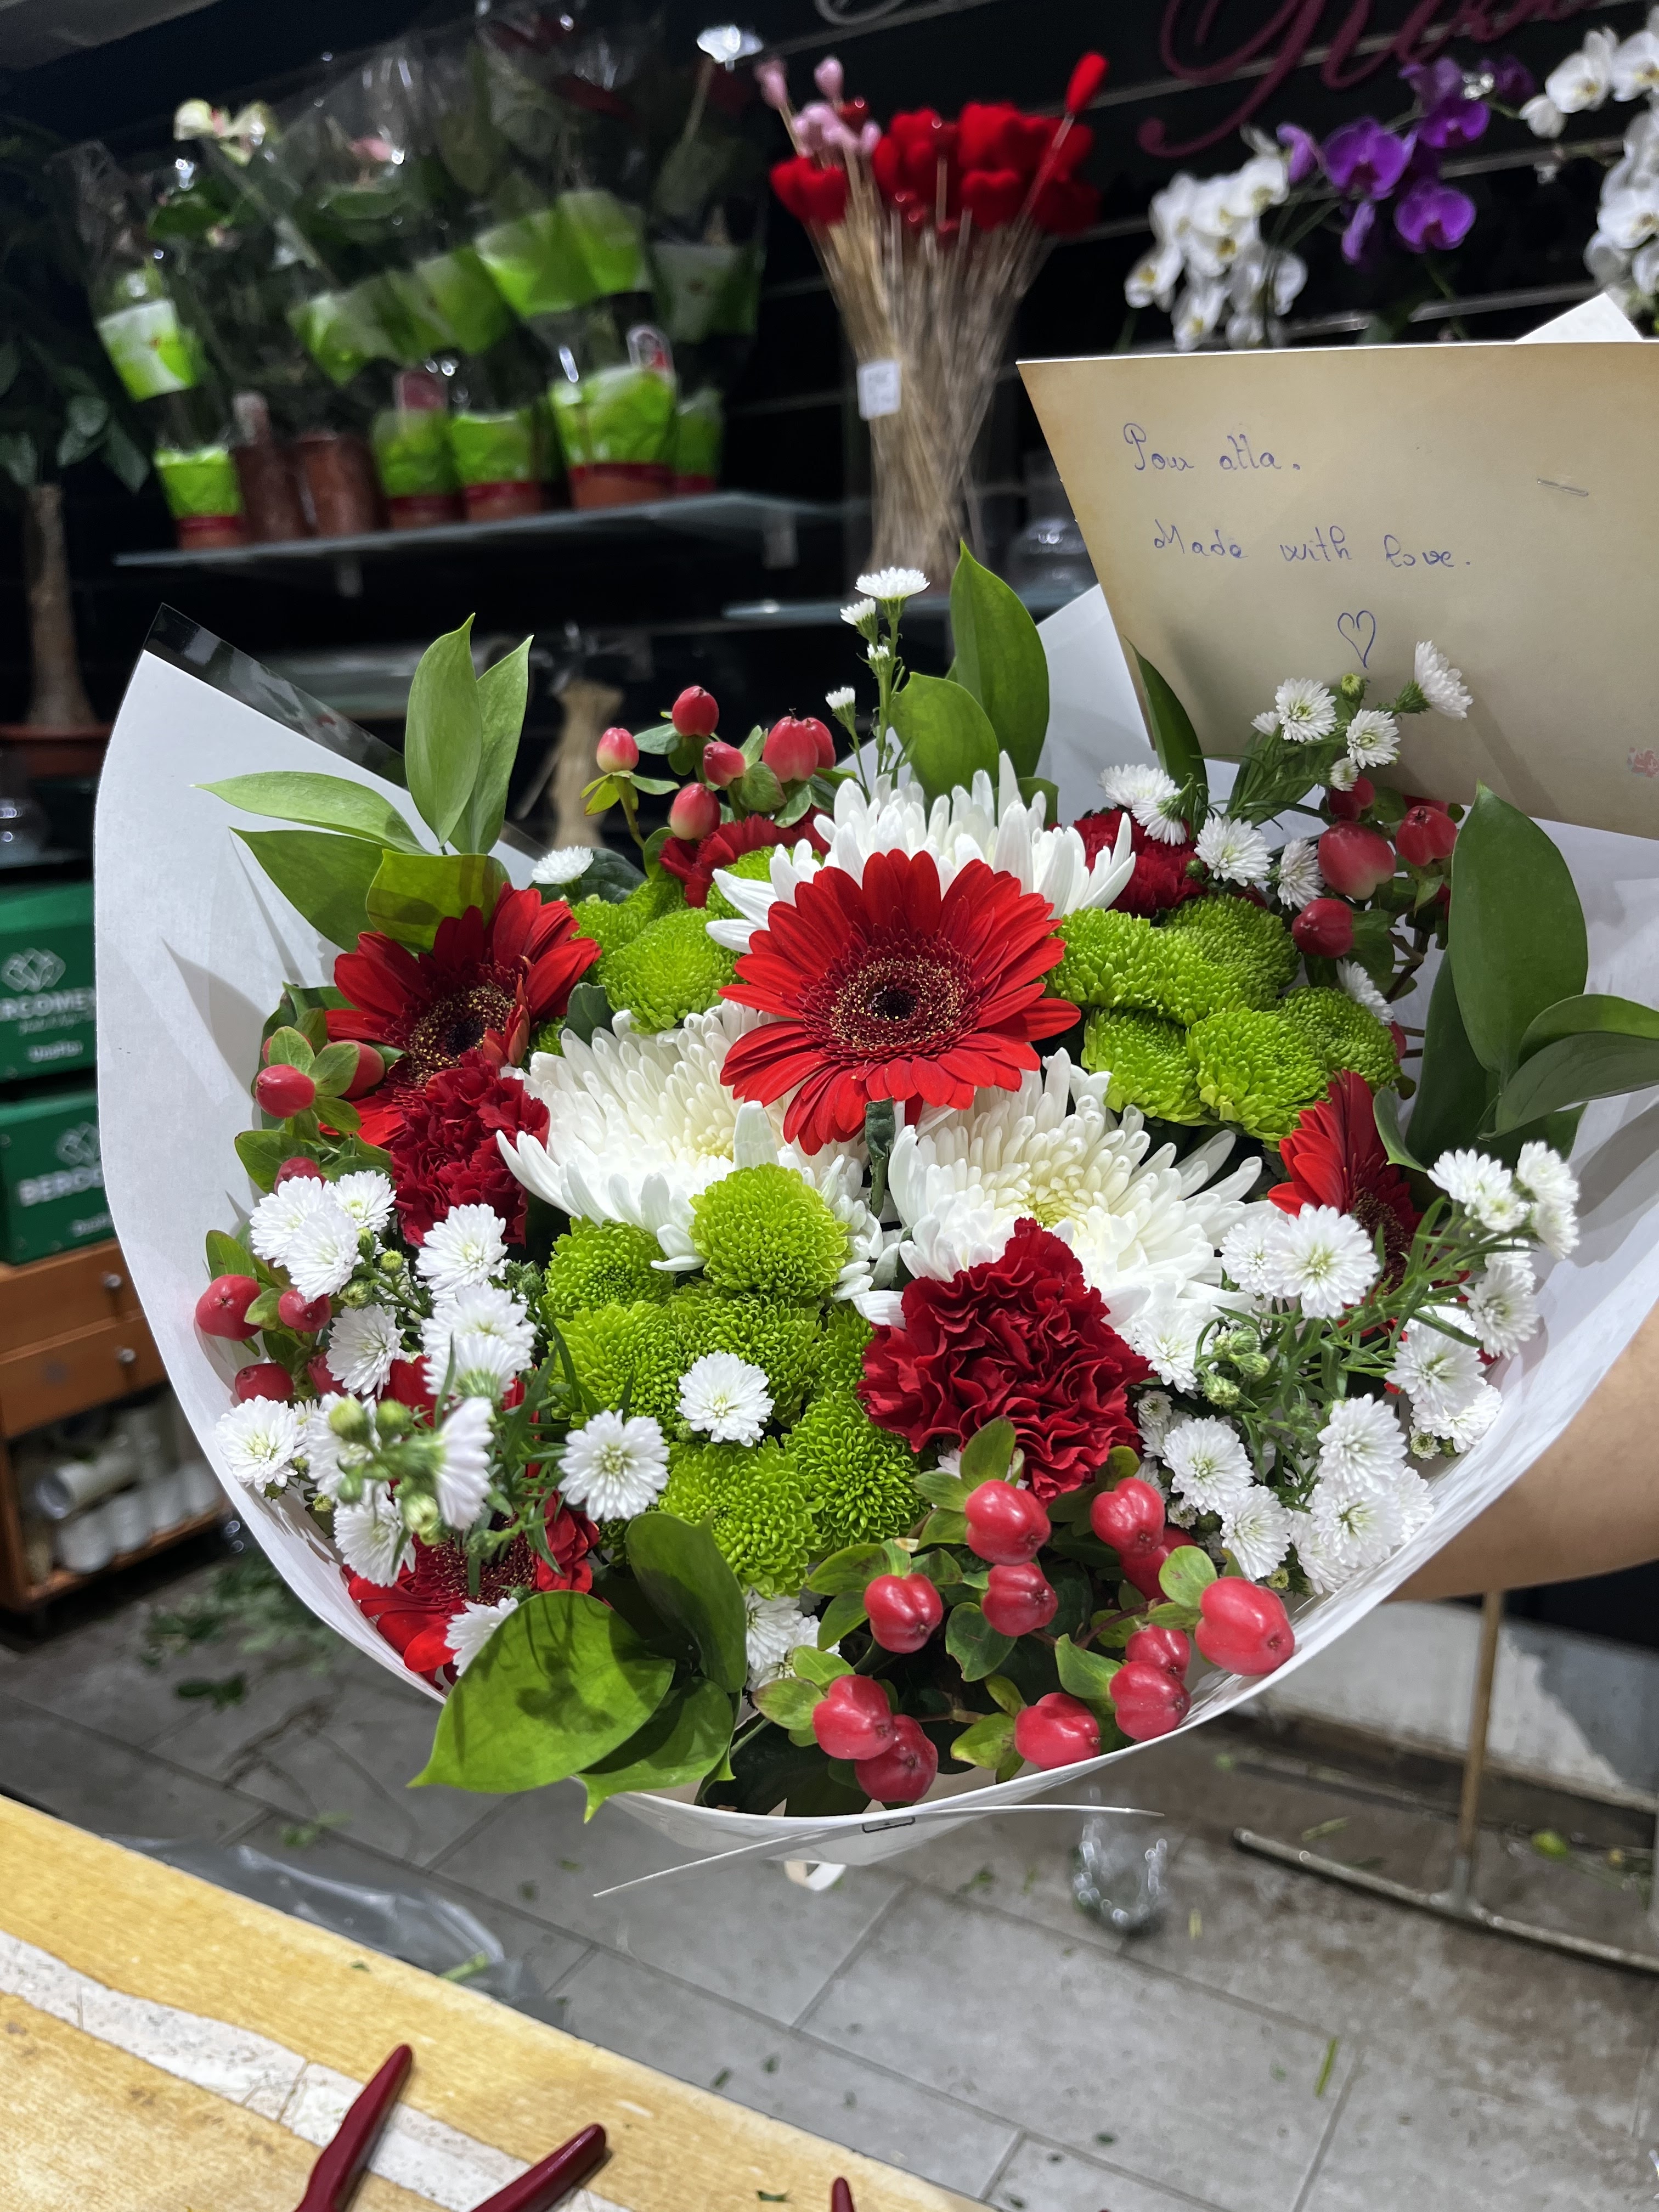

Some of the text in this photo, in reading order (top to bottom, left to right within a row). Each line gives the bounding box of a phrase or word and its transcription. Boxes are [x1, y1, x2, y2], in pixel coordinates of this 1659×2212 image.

[1153, 518, 1471, 568] Made with love.
